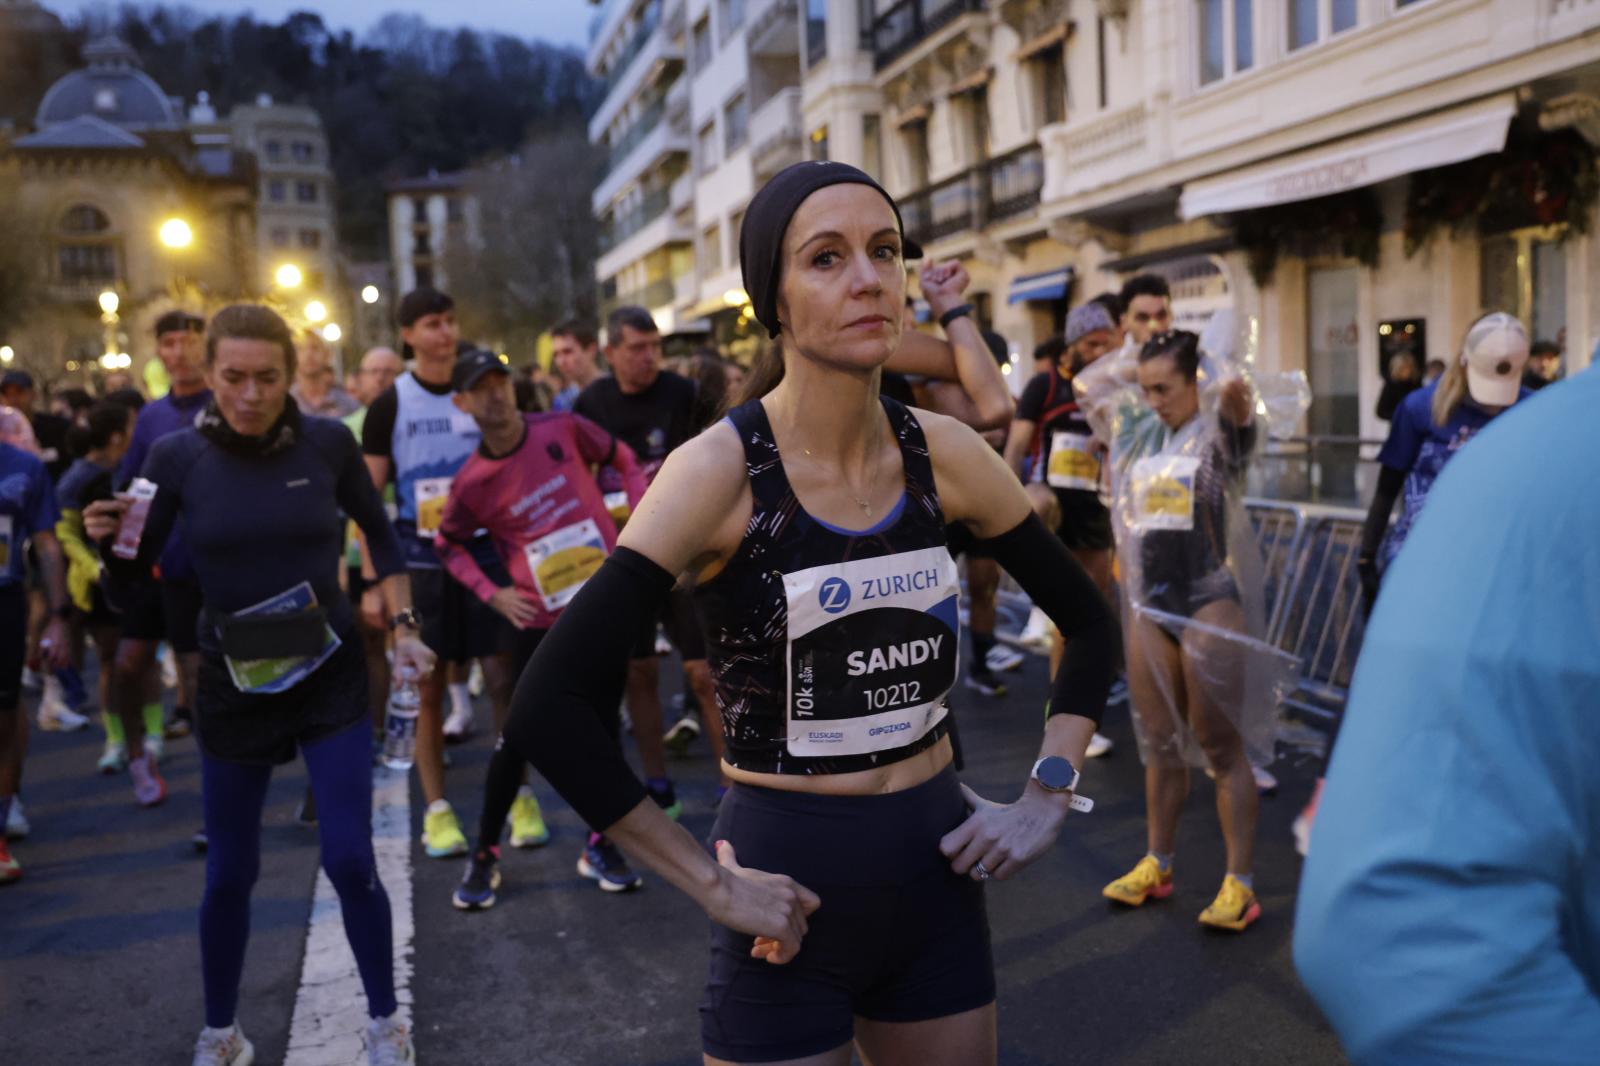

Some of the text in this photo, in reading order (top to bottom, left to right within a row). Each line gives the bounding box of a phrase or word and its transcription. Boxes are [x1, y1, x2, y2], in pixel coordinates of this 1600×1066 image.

[861, 568, 939, 600] ZURICH
[846, 634, 944, 676] SANDY
[795, 687, 814, 717] 10k
[863, 681, 921, 711] 10212
[808, 731, 844, 739] EUSKADI
